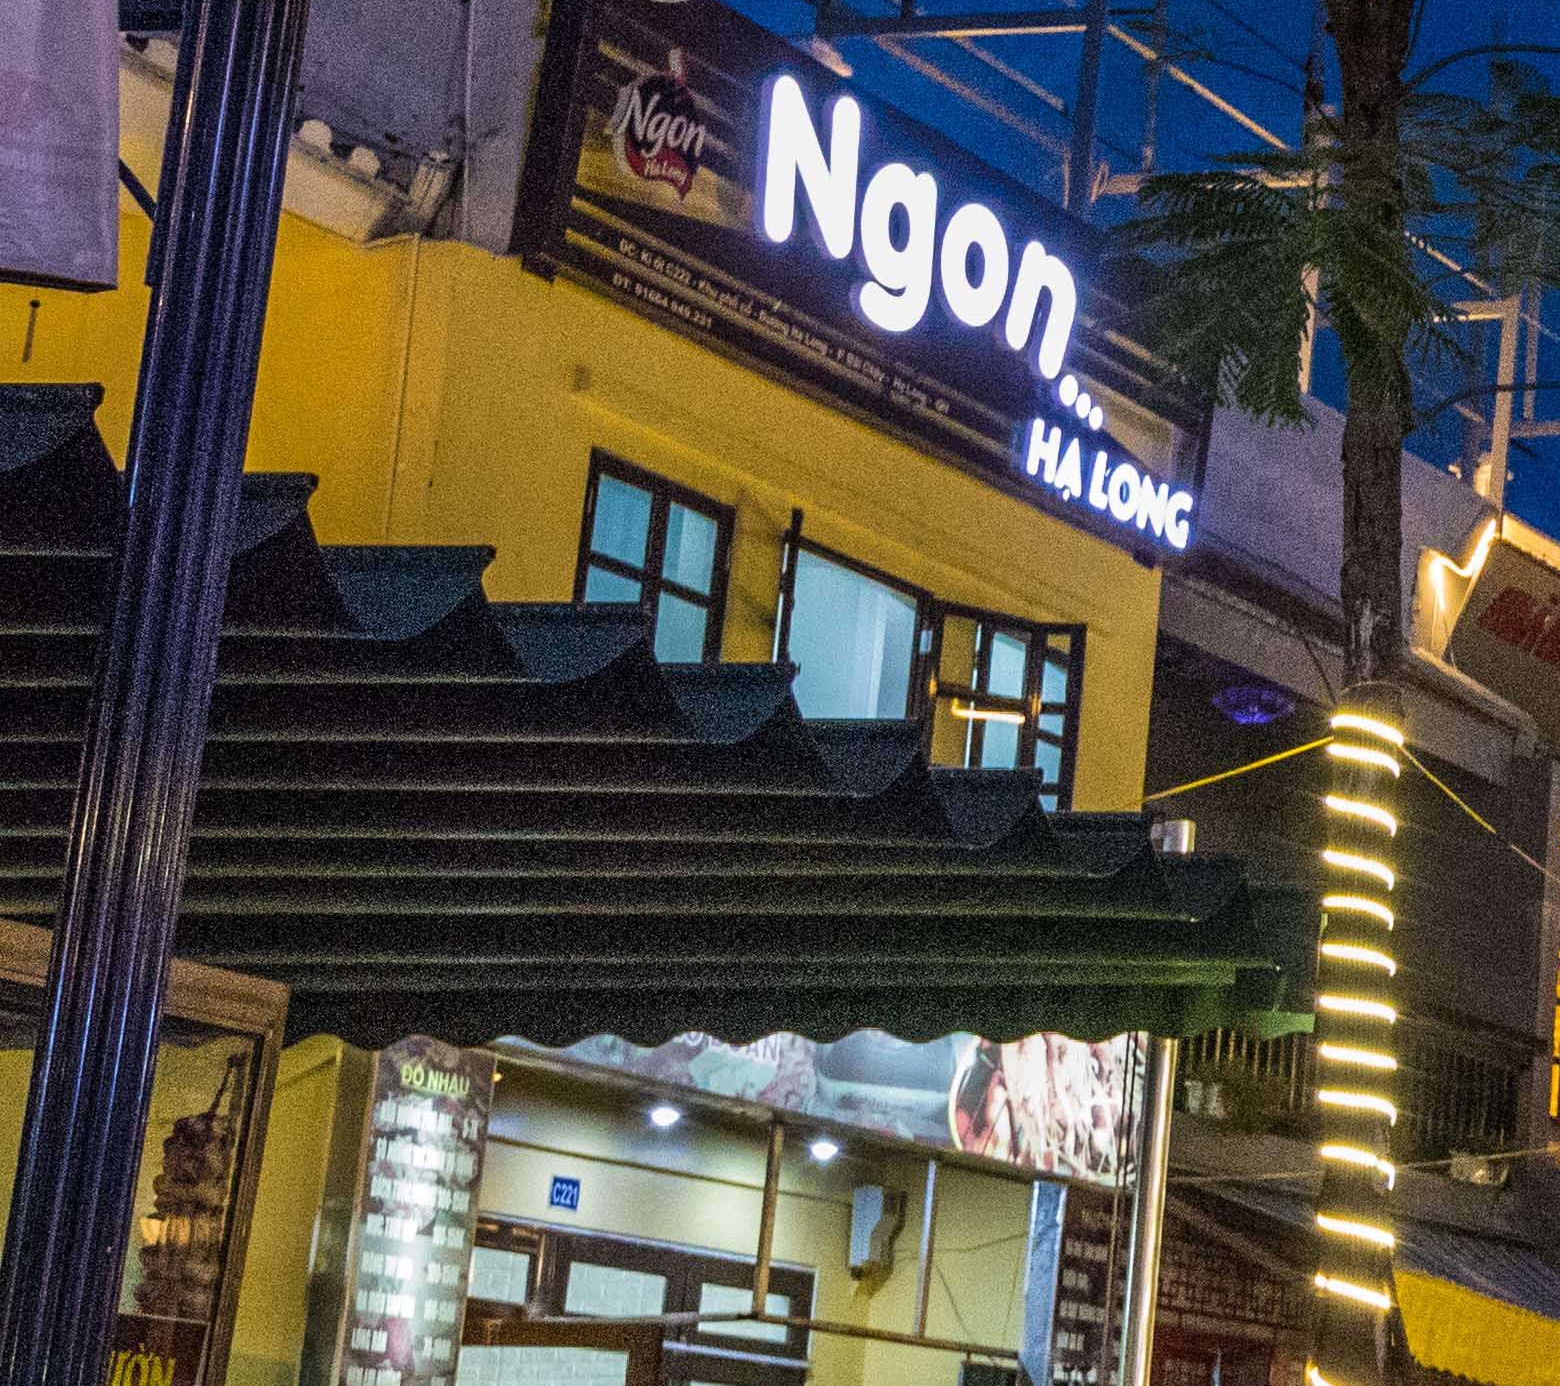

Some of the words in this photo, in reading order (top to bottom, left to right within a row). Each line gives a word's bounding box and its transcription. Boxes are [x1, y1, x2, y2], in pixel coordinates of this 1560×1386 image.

[617, 88, 705, 158] Ngon
[1027, 417, 1082, 500] HẠ
[1088, 449, 1194, 549] LONG
[553, 1182, 578, 1206] C221
